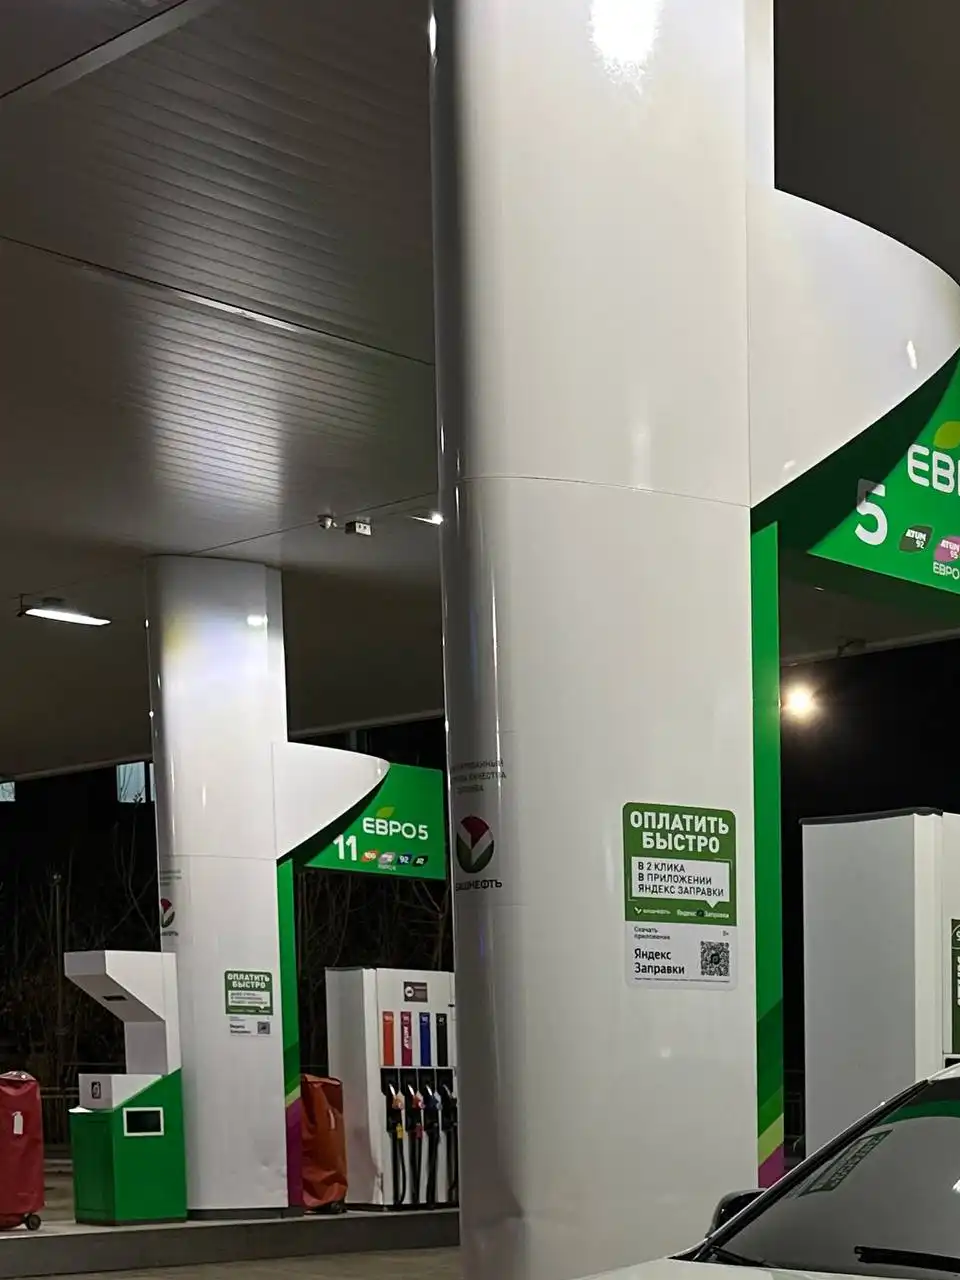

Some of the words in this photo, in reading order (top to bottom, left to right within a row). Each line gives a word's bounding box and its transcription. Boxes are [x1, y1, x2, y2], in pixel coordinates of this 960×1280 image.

[854, 478, 888, 546] 5
[905, 529, 927, 542] ATUM
[915, 540, 925, 549] 92
[940, 539, 960, 552] ATUM
[629, 811, 730, 834] ОПЛАТИТЬ
[333, 834, 358, 861] 11
[642, 831, 720, 853] БЫСТРО
[637, 861, 644, 871] В
[646, 862, 652, 871] 2
[654, 862, 686, 873] КЛИКА
[637, 873, 644, 882] В
[647, 874, 712, 886] ПРИЛОЖЕНИИ
[637, 884, 676, 895] ЯНДЕКС
[677, 886, 724, 897] ЗАПРАВКИ
[634, 948, 672, 961] Яндекс
[634, 962, 685, 976] Заправки
[227, 973, 270, 982] ОПЛАТИТЬ
[232, 981, 266, 989] БЫСТРО
